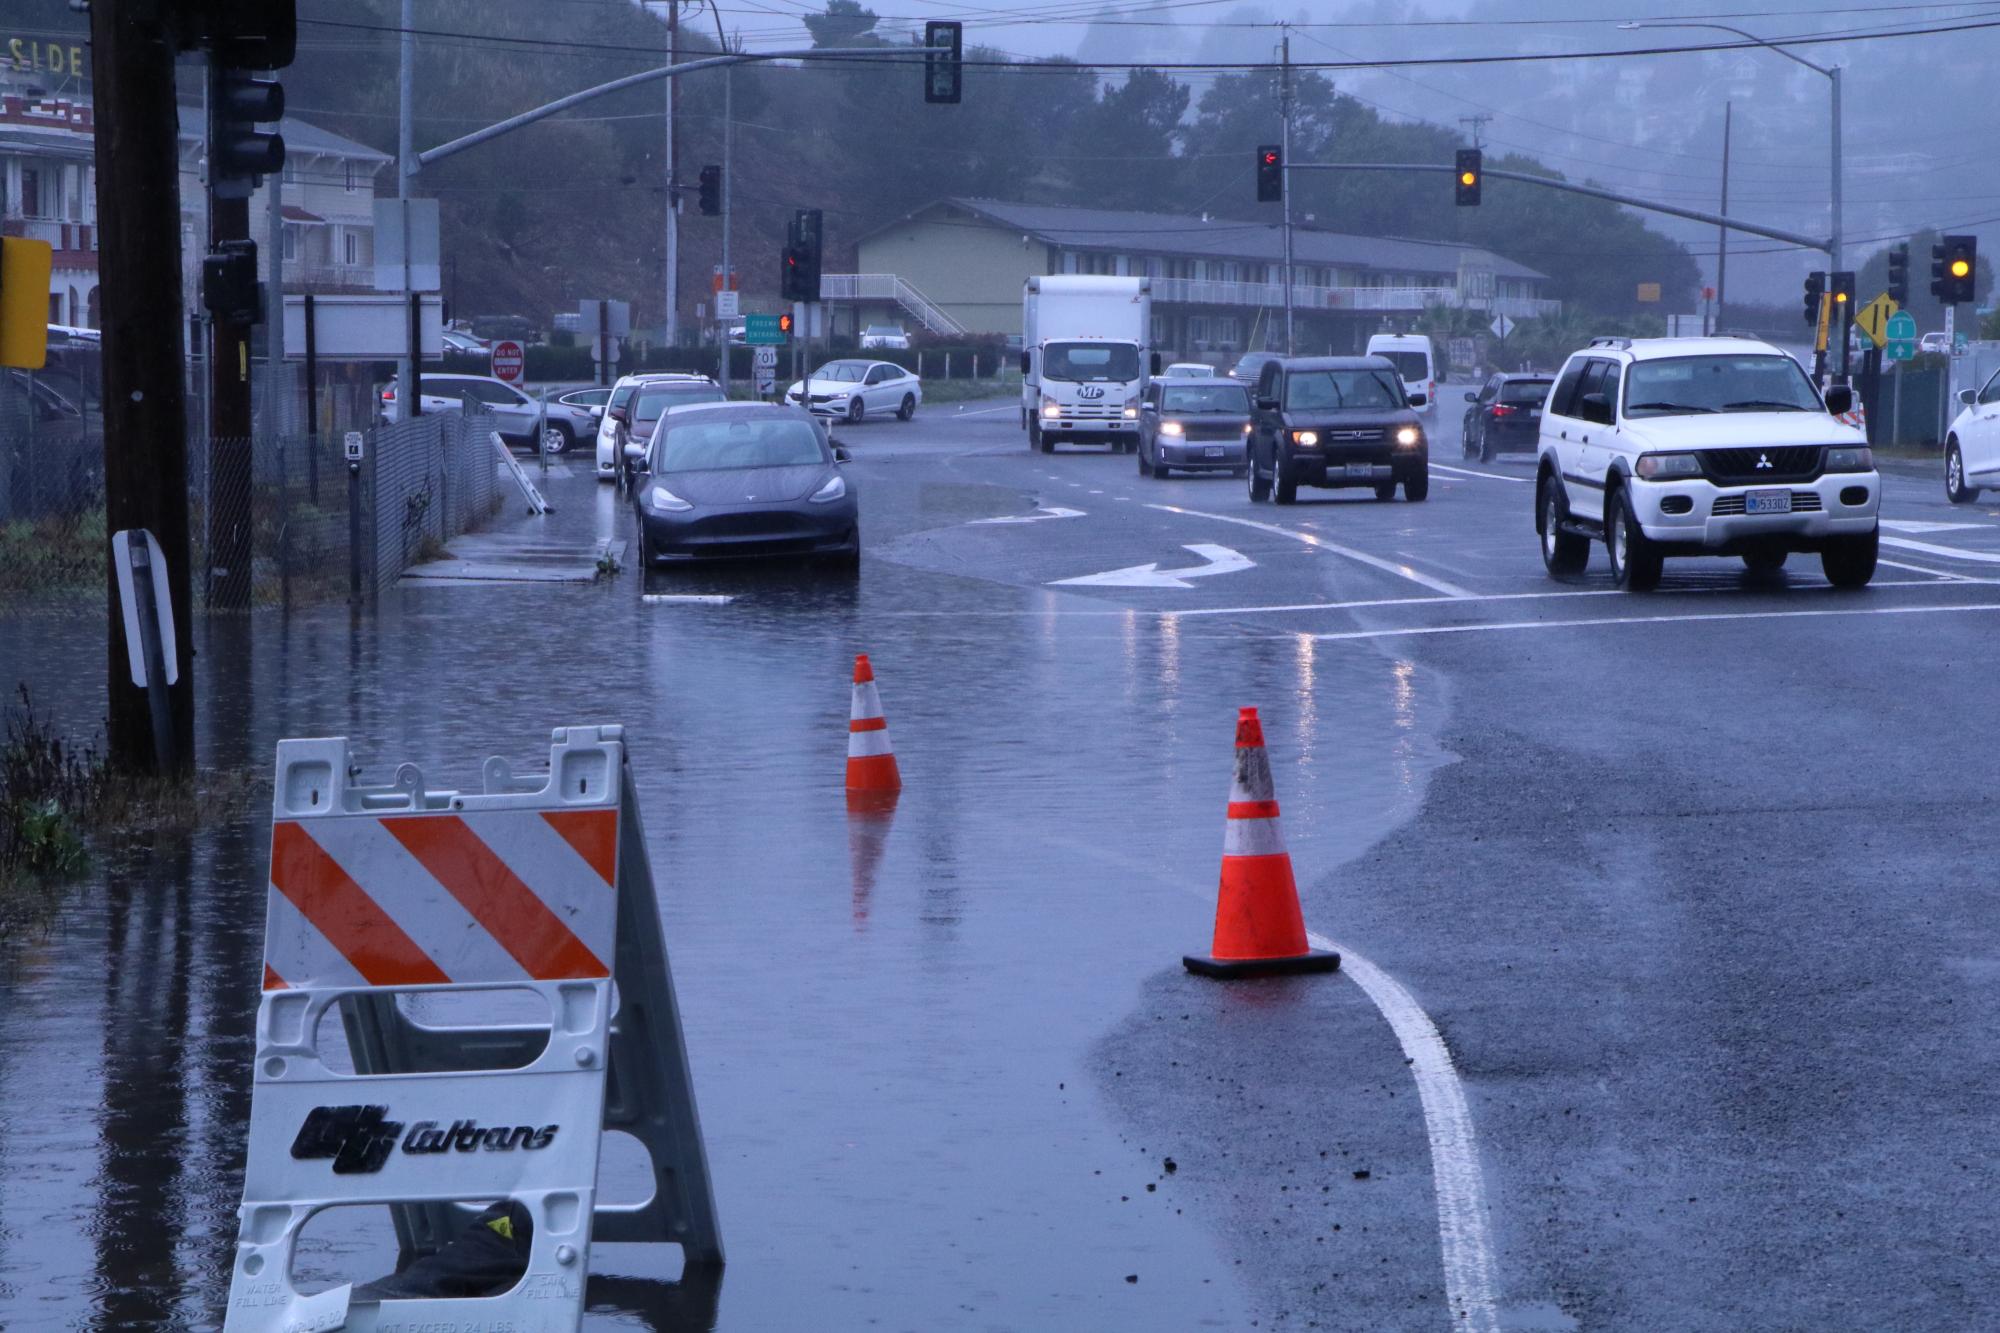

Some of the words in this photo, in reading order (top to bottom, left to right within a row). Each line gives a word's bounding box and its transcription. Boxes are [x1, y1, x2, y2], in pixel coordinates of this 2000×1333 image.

[8, 38, 83, 77] SIDE
[496, 349, 505, 357] DO
[508, 348, 520, 356] NOT
[497, 366, 518, 375] ENTER
[1079, 386, 1102, 398] MF
[401, 1119, 560, 1156] Caltrans
[245, 1282, 281, 1296] WATER
[235, 1296, 259, 1308] FILL
[464, 1321, 481, 1333] 24
